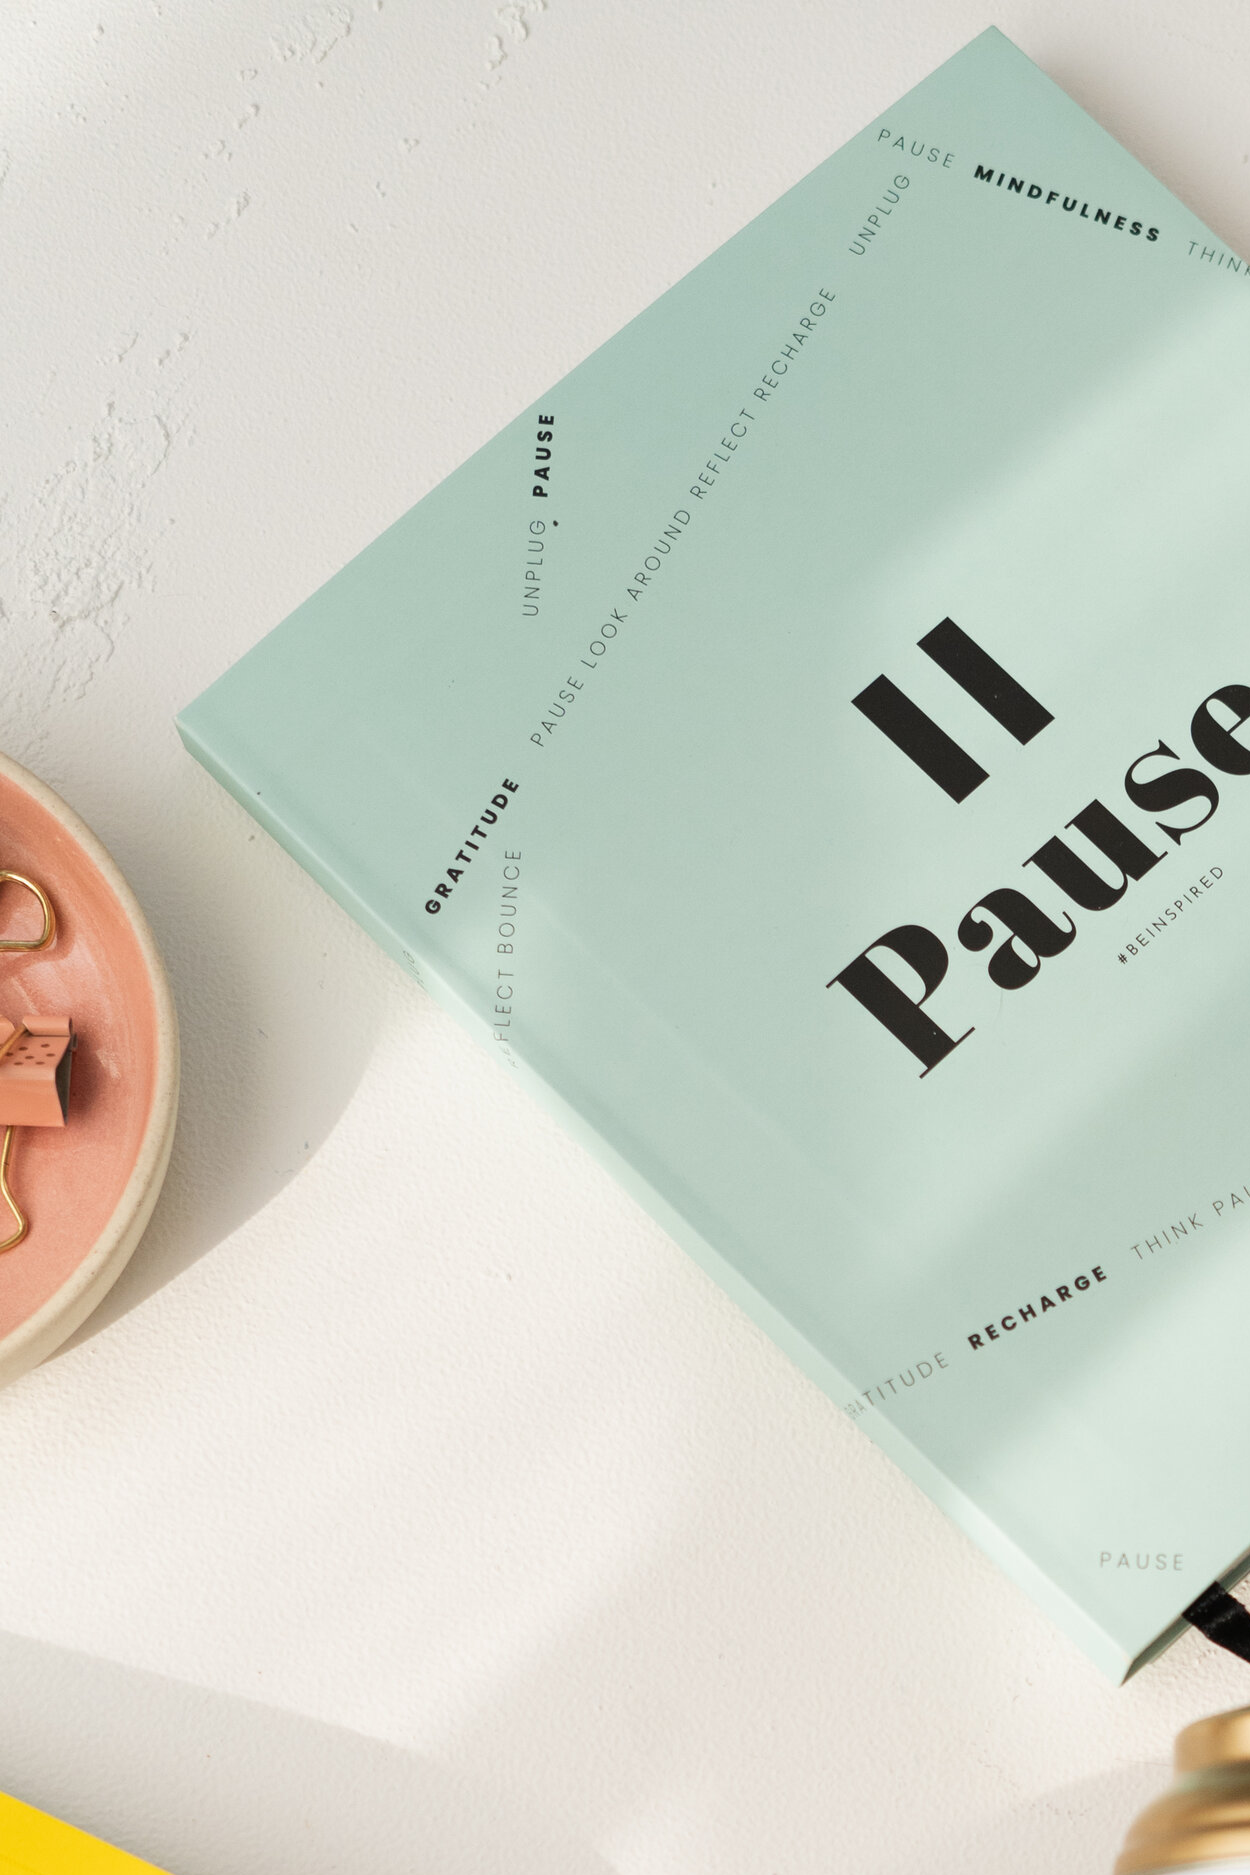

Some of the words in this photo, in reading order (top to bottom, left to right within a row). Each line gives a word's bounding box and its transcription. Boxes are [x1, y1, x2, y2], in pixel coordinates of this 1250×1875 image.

[877, 128, 956, 169] PAUSE
[973, 164, 1160, 242] MINDFULNESS
[532, 413, 554, 498] PAUSE
[424, 776, 519, 915] GRATITUDE
[530, 676, 584, 747] PAUSE
[581, 608, 628, 669] LOOK
[627, 509, 691, 602] AROUND
[690, 408, 756, 499] REFLECT
[753, 287, 836, 402] RECHARGE
[848, 174, 910, 256] UNPLUG
[521, 519, 546, 616] UNPLUG
[496, 849, 522, 955] BOUNCE
[1116, 865, 1224, 965] #BEINSPIRED
[967, 1266, 1108, 1350] RECHARGE
[1130, 1213, 1204, 1261] THINK
[1099, 1551, 1185, 1572] PAUSE
